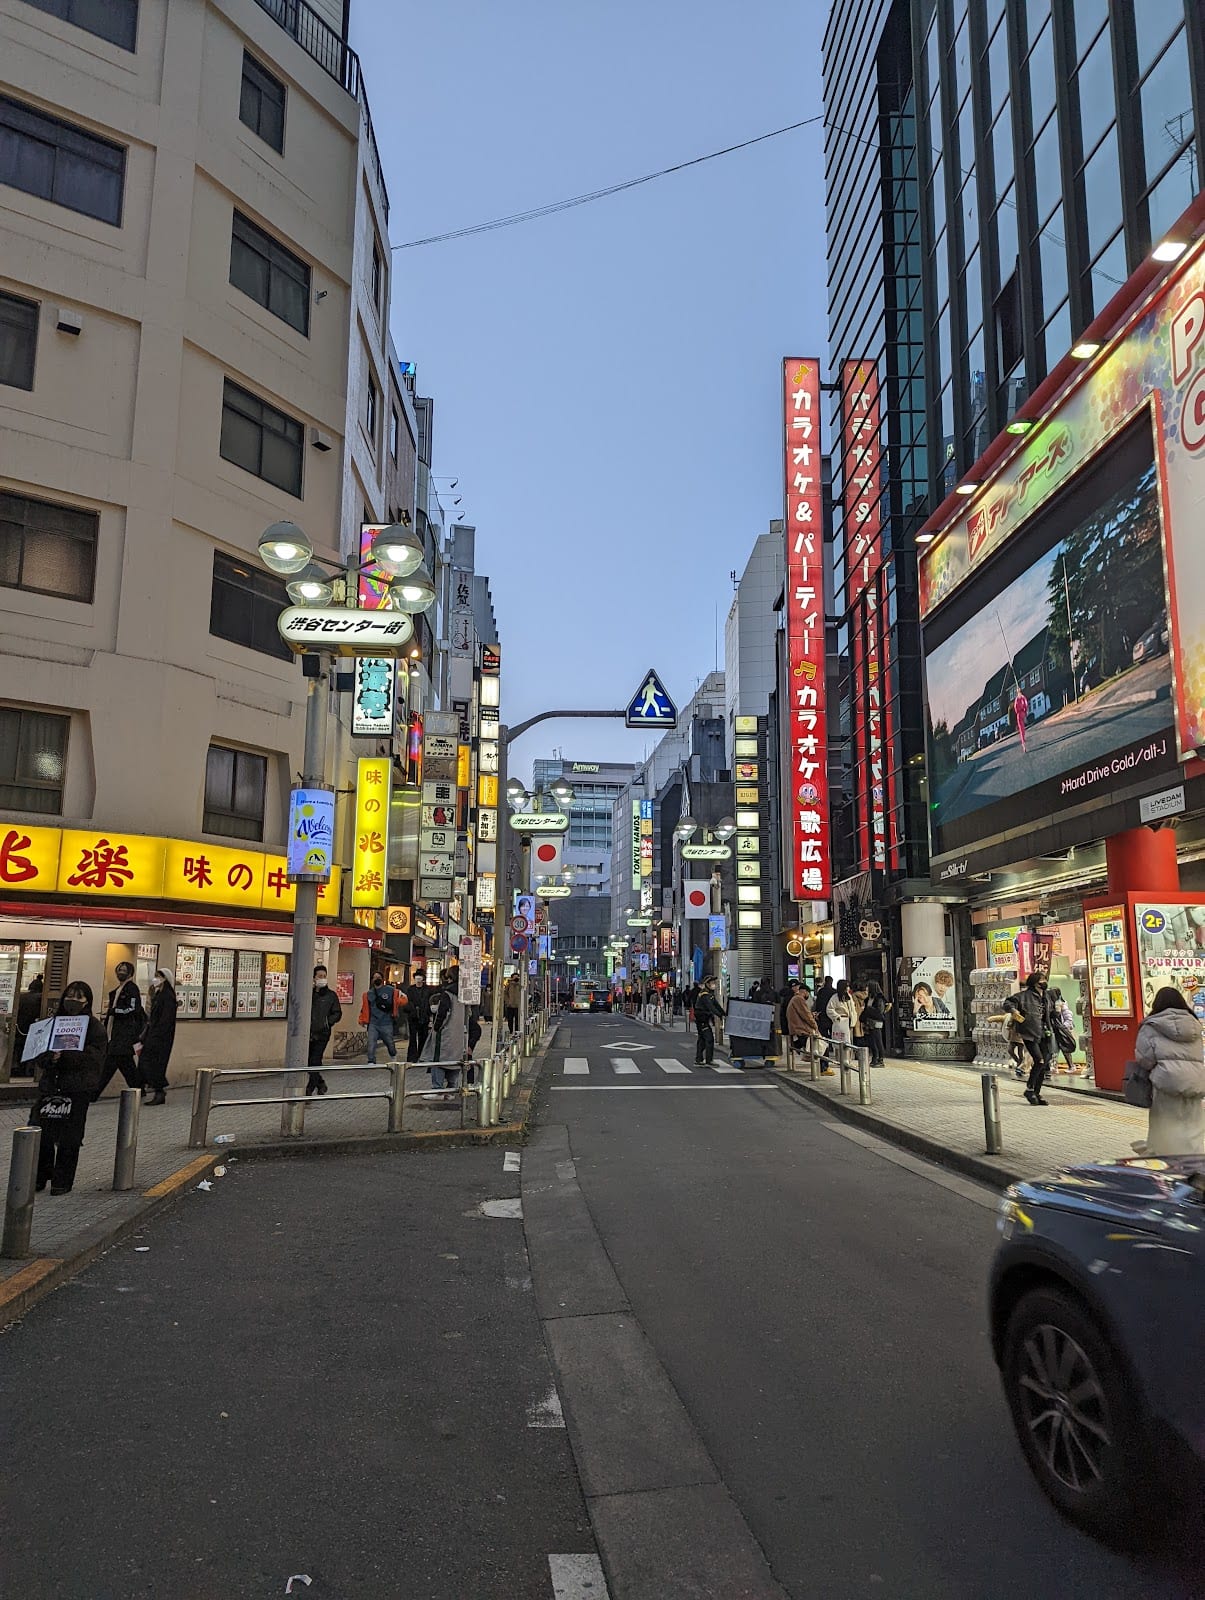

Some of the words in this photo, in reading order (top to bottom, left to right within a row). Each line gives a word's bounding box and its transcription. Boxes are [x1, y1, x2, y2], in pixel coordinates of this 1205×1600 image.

[286, 617, 406, 635] 渋谷センター街
[797, 686, 820, 779] カラオケ
[572, 763, 599, 772] Amway
[1066, 773, 1085, 792] Hard
[1087, 766, 1109, 784] Drive
[1151, 800, 1183, 813] STADIUM
[356, 769, 385, 892] 味の兆楽
[799, 810, 823, 891] 歌広場
[1145, 915, 1162, 928] 2F
[1148, 958, 1205, 967] PURIKUR
[40, 1102, 72, 1114] Asahi
